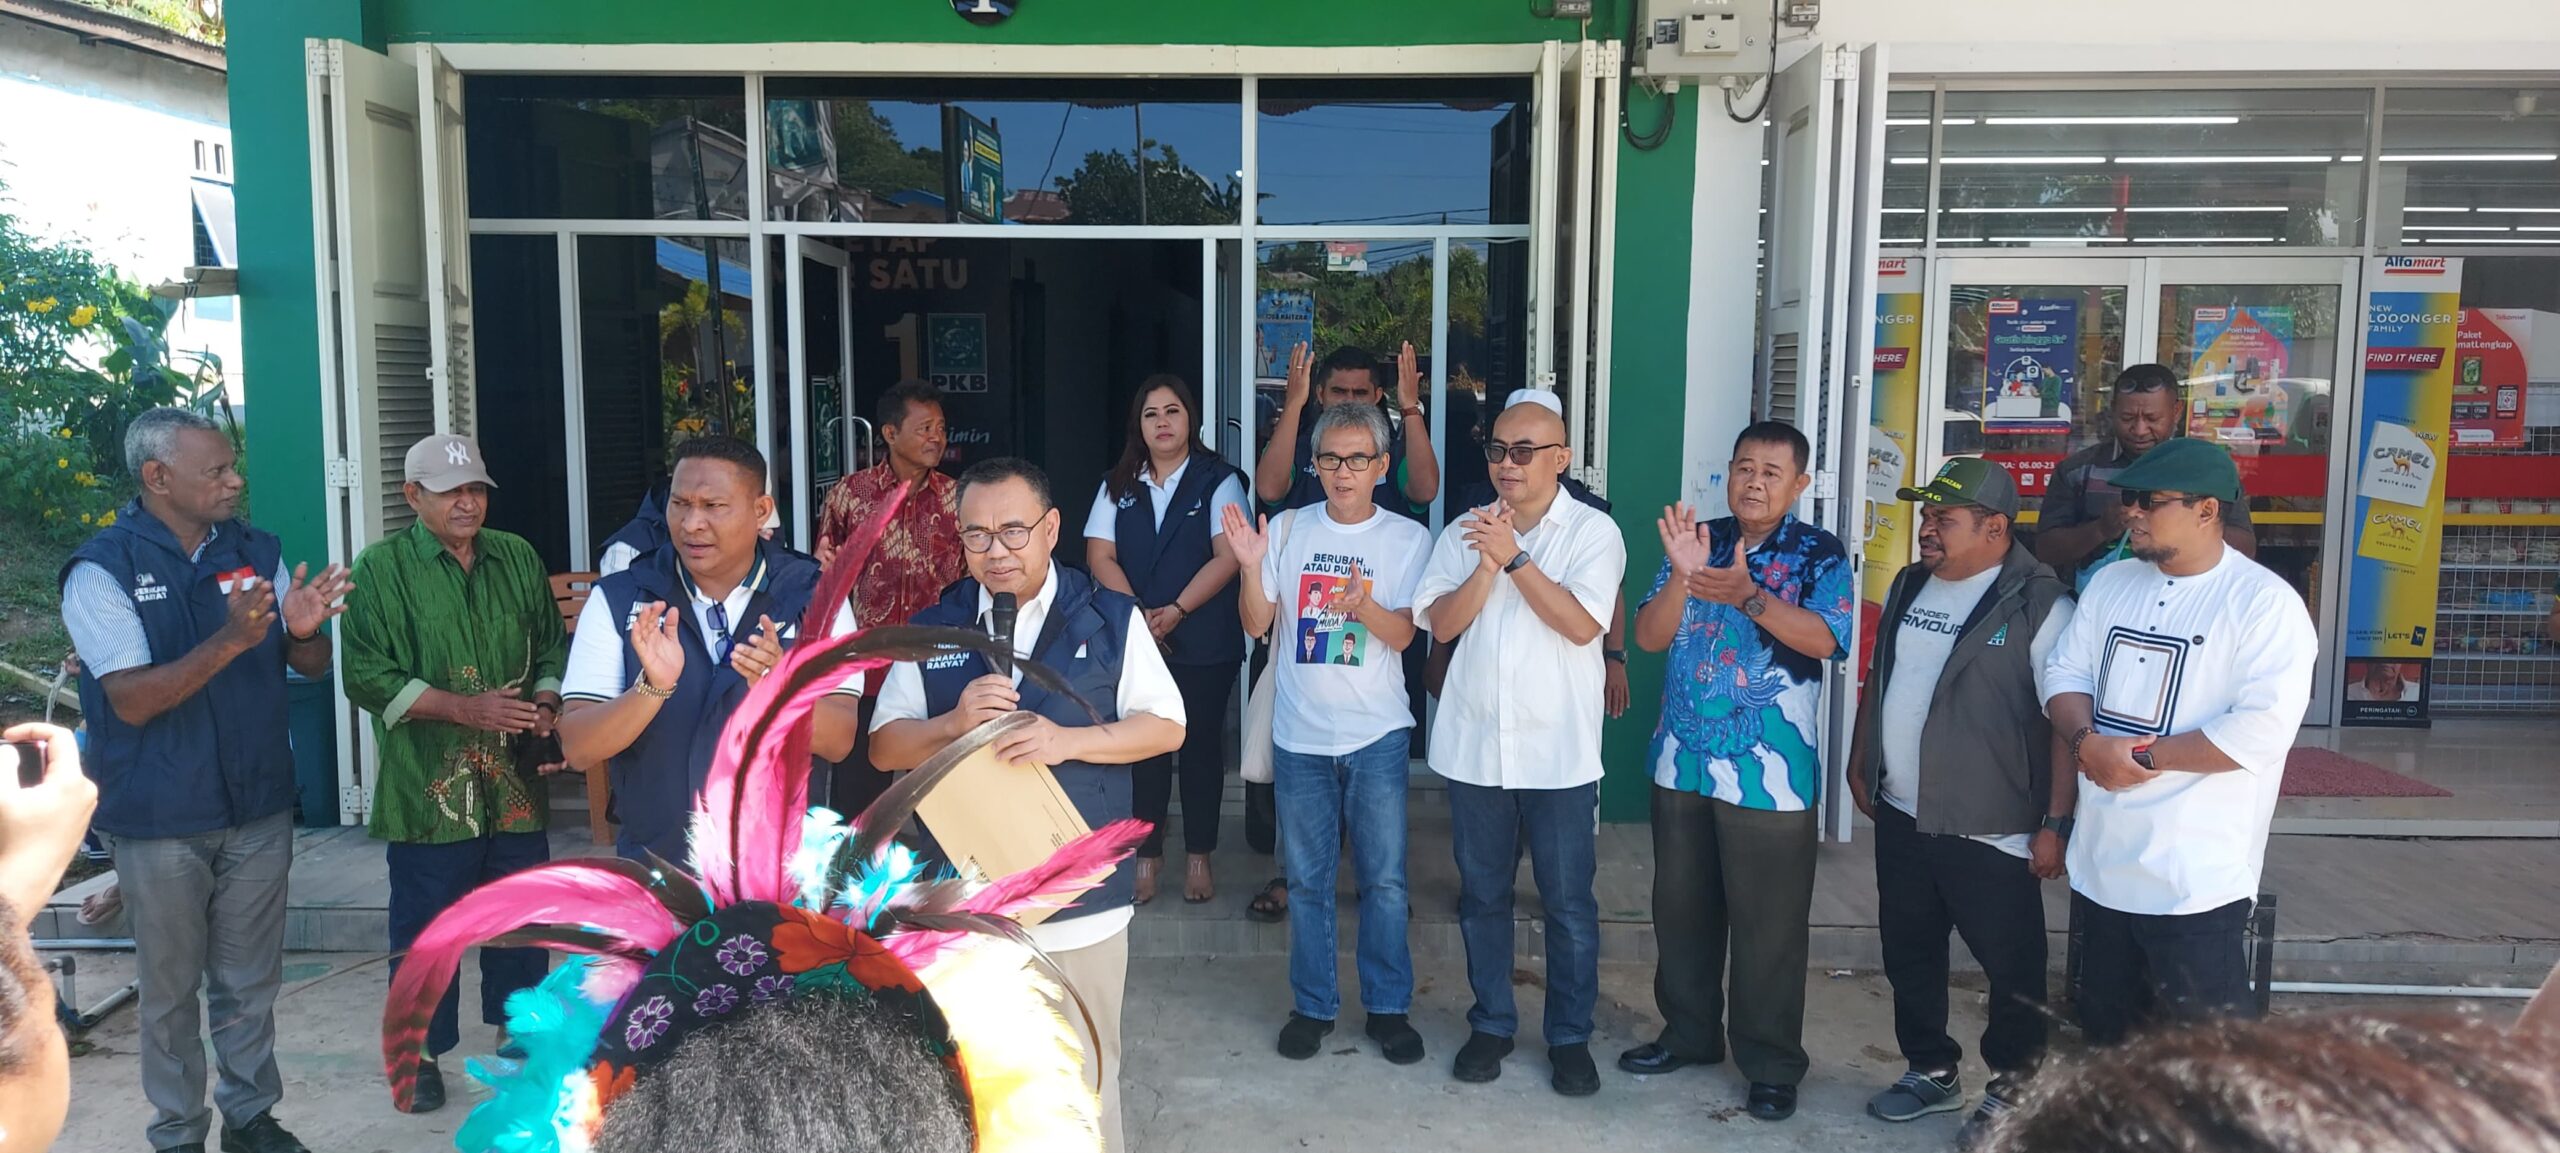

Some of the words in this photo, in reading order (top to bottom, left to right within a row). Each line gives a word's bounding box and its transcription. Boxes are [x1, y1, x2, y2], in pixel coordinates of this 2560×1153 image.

[1878, 259, 1907, 269] mart
[2384, 256, 2446, 268] Alfamart
[869, 258, 968, 290] SATU
[1875, 314, 1915, 324] NGER
[2368, 313, 2452, 324] LOOONGER
[2368, 325, 2403, 333] FAMILY
[2457, 331, 2482, 339] Paket
[2456, 341, 2513, 350] matLengkap
[2367, 354, 2393, 363] FIND
[2395, 354, 2407, 363] IT
[2408, 354, 2437, 363] HERE
[930, 374, 987, 392] PKB
[949, 427, 990, 445] imin
[2416, 431, 2438, 441] NEW
[1868, 447, 1900, 467] MEL
[2373, 447, 2431, 469] CAMEL
[2371, 512, 2423, 533] CAMEL
[1303, 563, 1331, 573] ATAU
[1912, 607, 1950, 620] UNDER
[2387, 632, 2410, 640] LET'S
[927, 652, 970, 662] ERAKAN
[926, 659, 966, 670] RAKYAT
